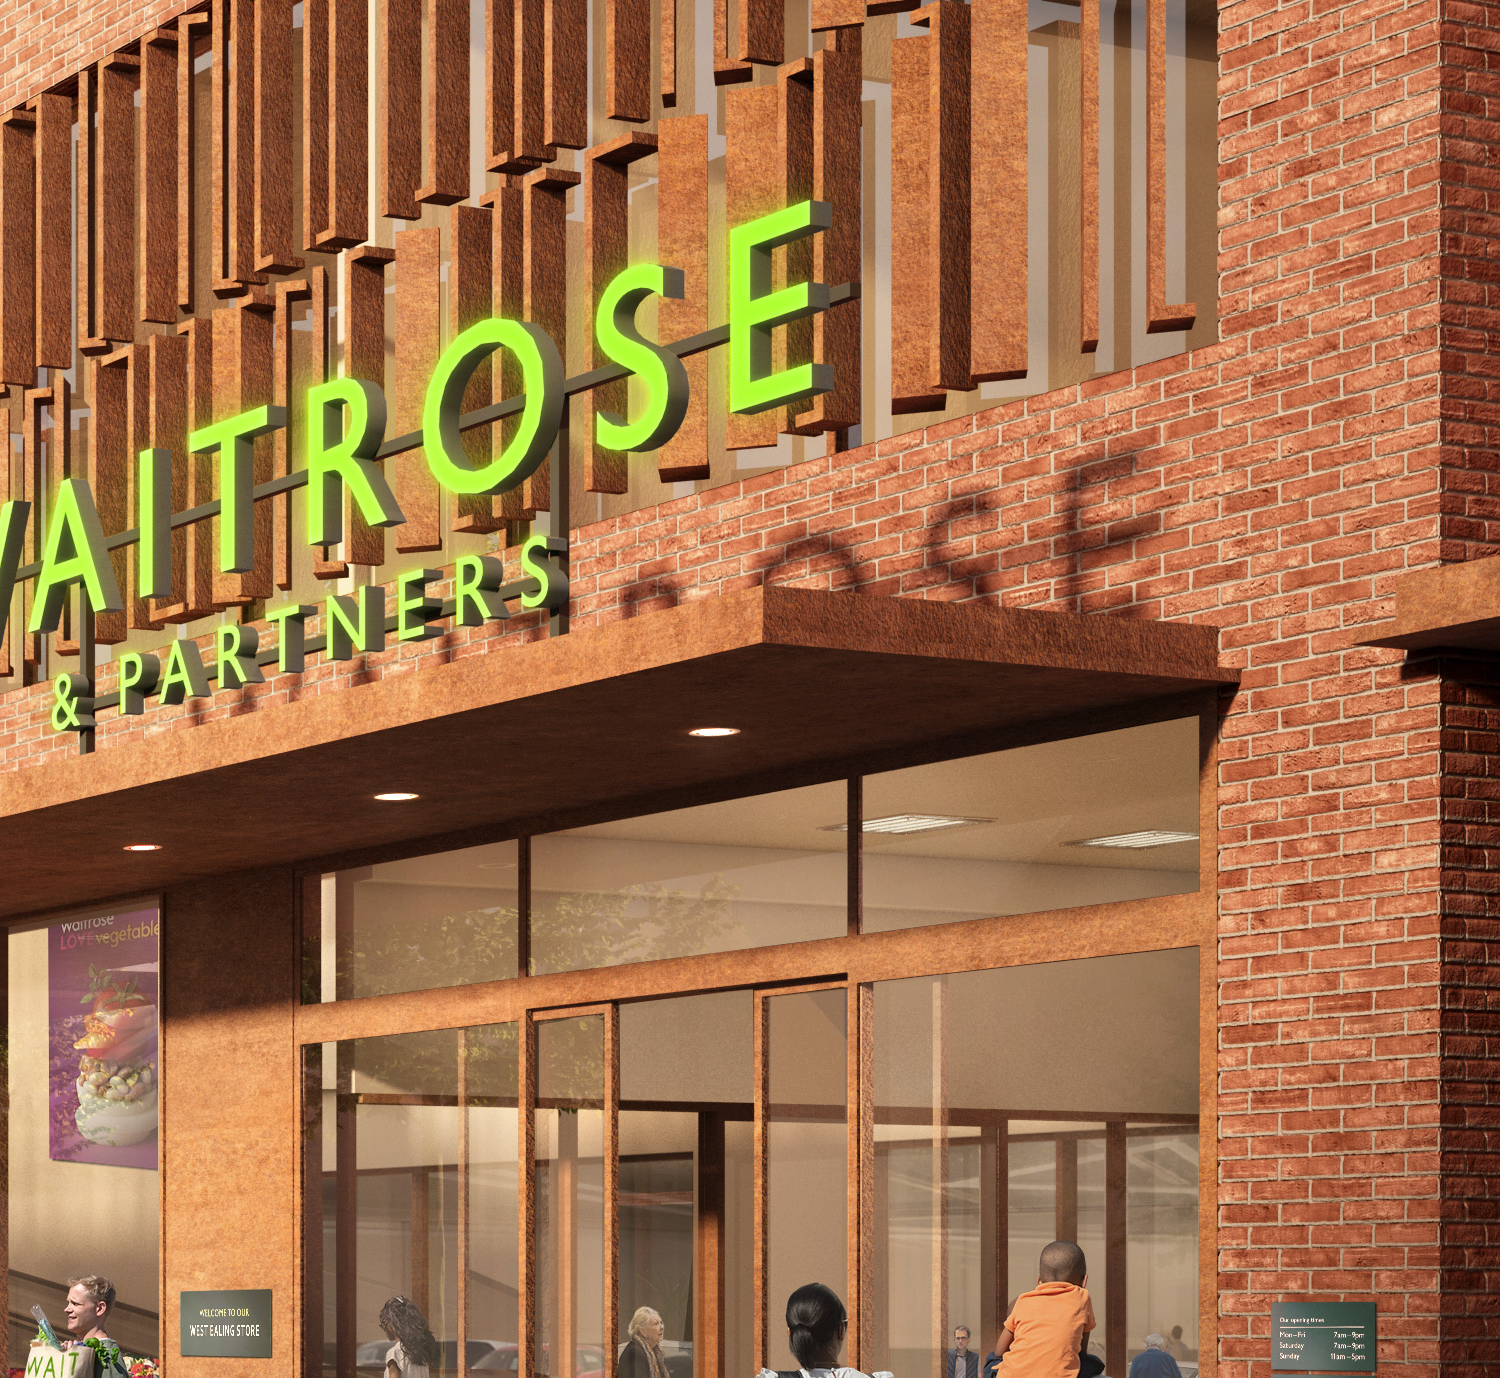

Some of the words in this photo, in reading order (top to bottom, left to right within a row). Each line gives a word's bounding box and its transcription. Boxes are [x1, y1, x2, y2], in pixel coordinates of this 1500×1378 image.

[50, 675, 91, 732] &
[118, 534, 566, 718] PARTNERS
[60, 931, 93, 950] LOVE
[199, 1309, 226, 1317] WELCOME
[228, 1309, 235, 1317] TO
[237, 1308, 249, 1317] OUR
[190, 1325, 208, 1336] WEST
[210, 1325, 234, 1336] EALING
[237, 1325, 260, 1336] STORE
[1280, 1342, 1304, 1350] Saturday
[28, 1352, 79, 1378] WAIT
